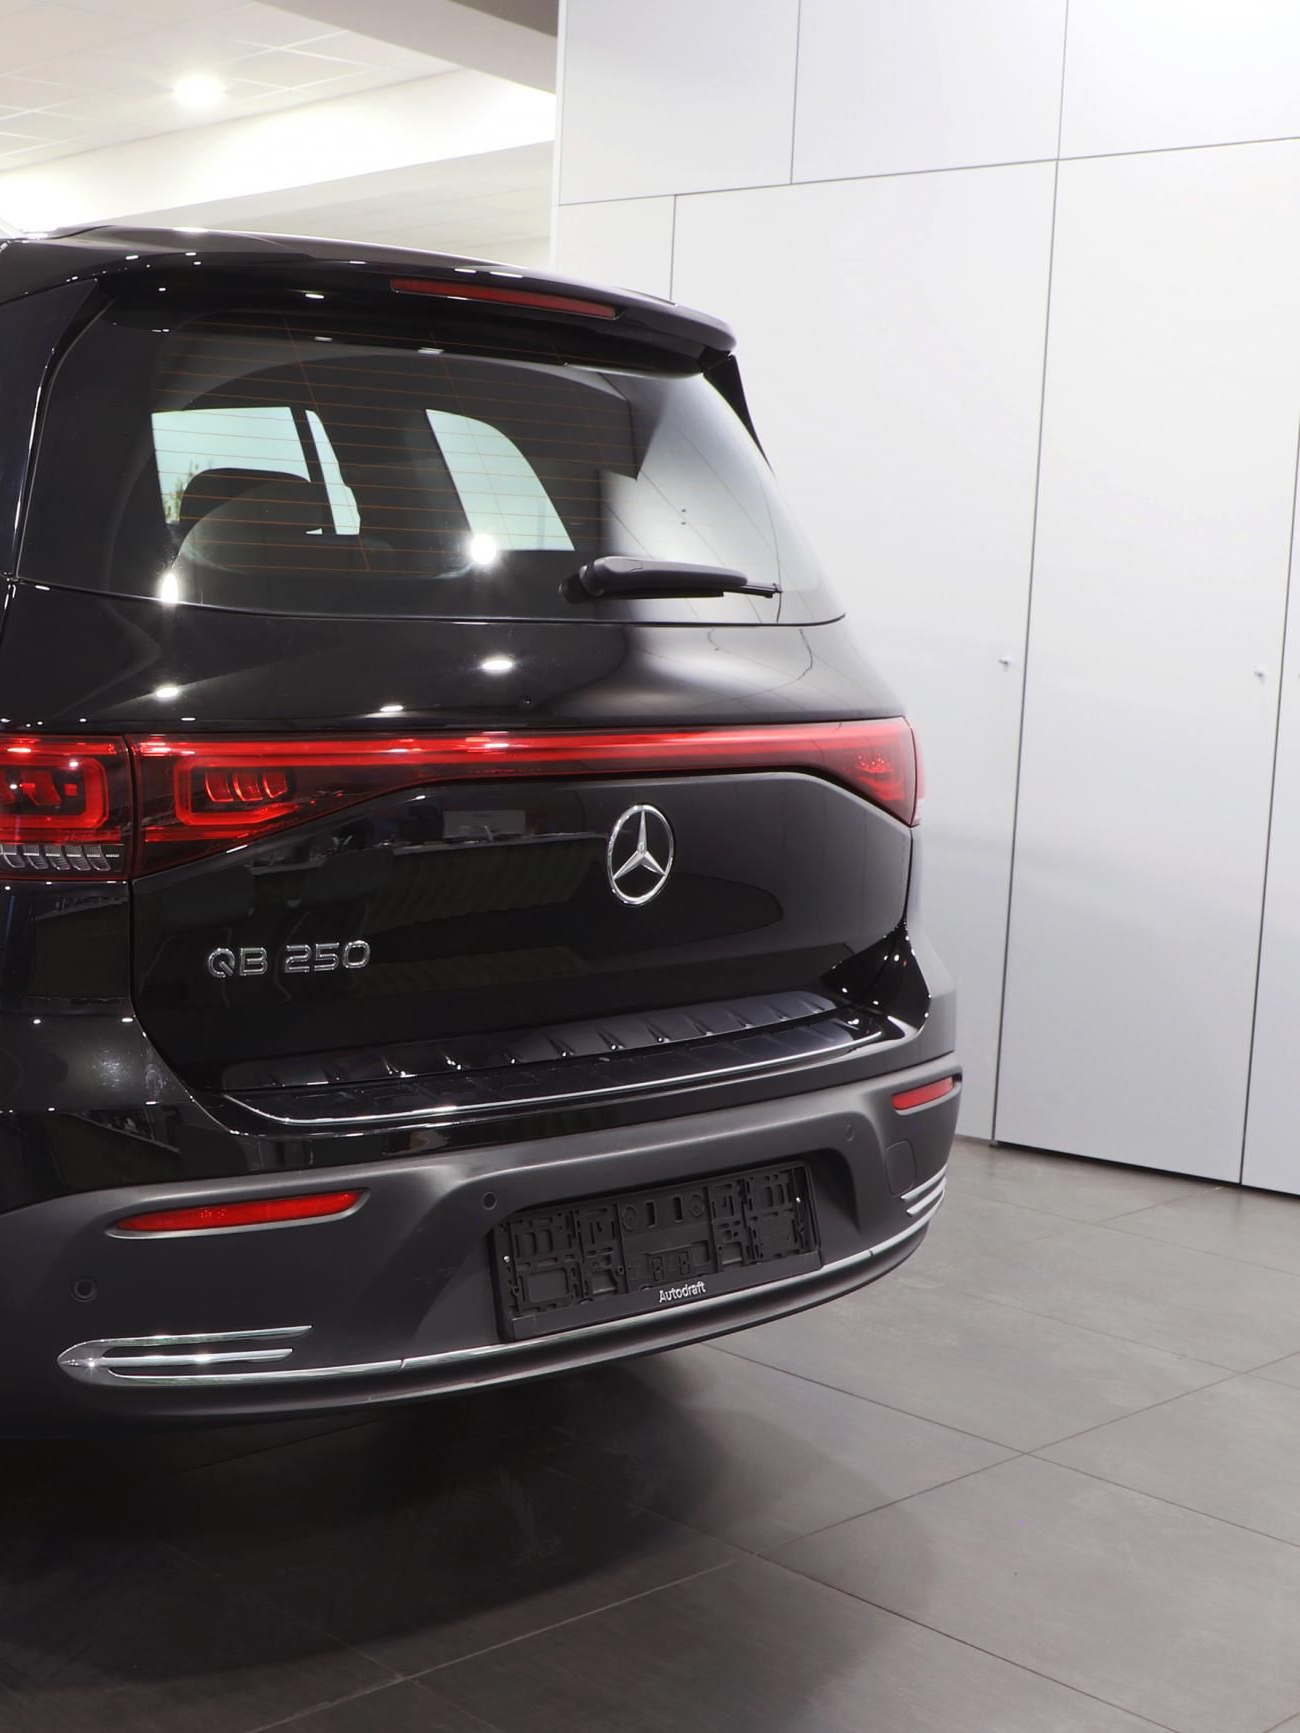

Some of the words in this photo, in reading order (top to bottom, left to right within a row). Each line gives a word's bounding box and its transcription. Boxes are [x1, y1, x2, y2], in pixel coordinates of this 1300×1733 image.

[207, 947, 268, 978] QB
[284, 939, 371, 974] 250
[659, 1281, 706, 1303] Autodraft
